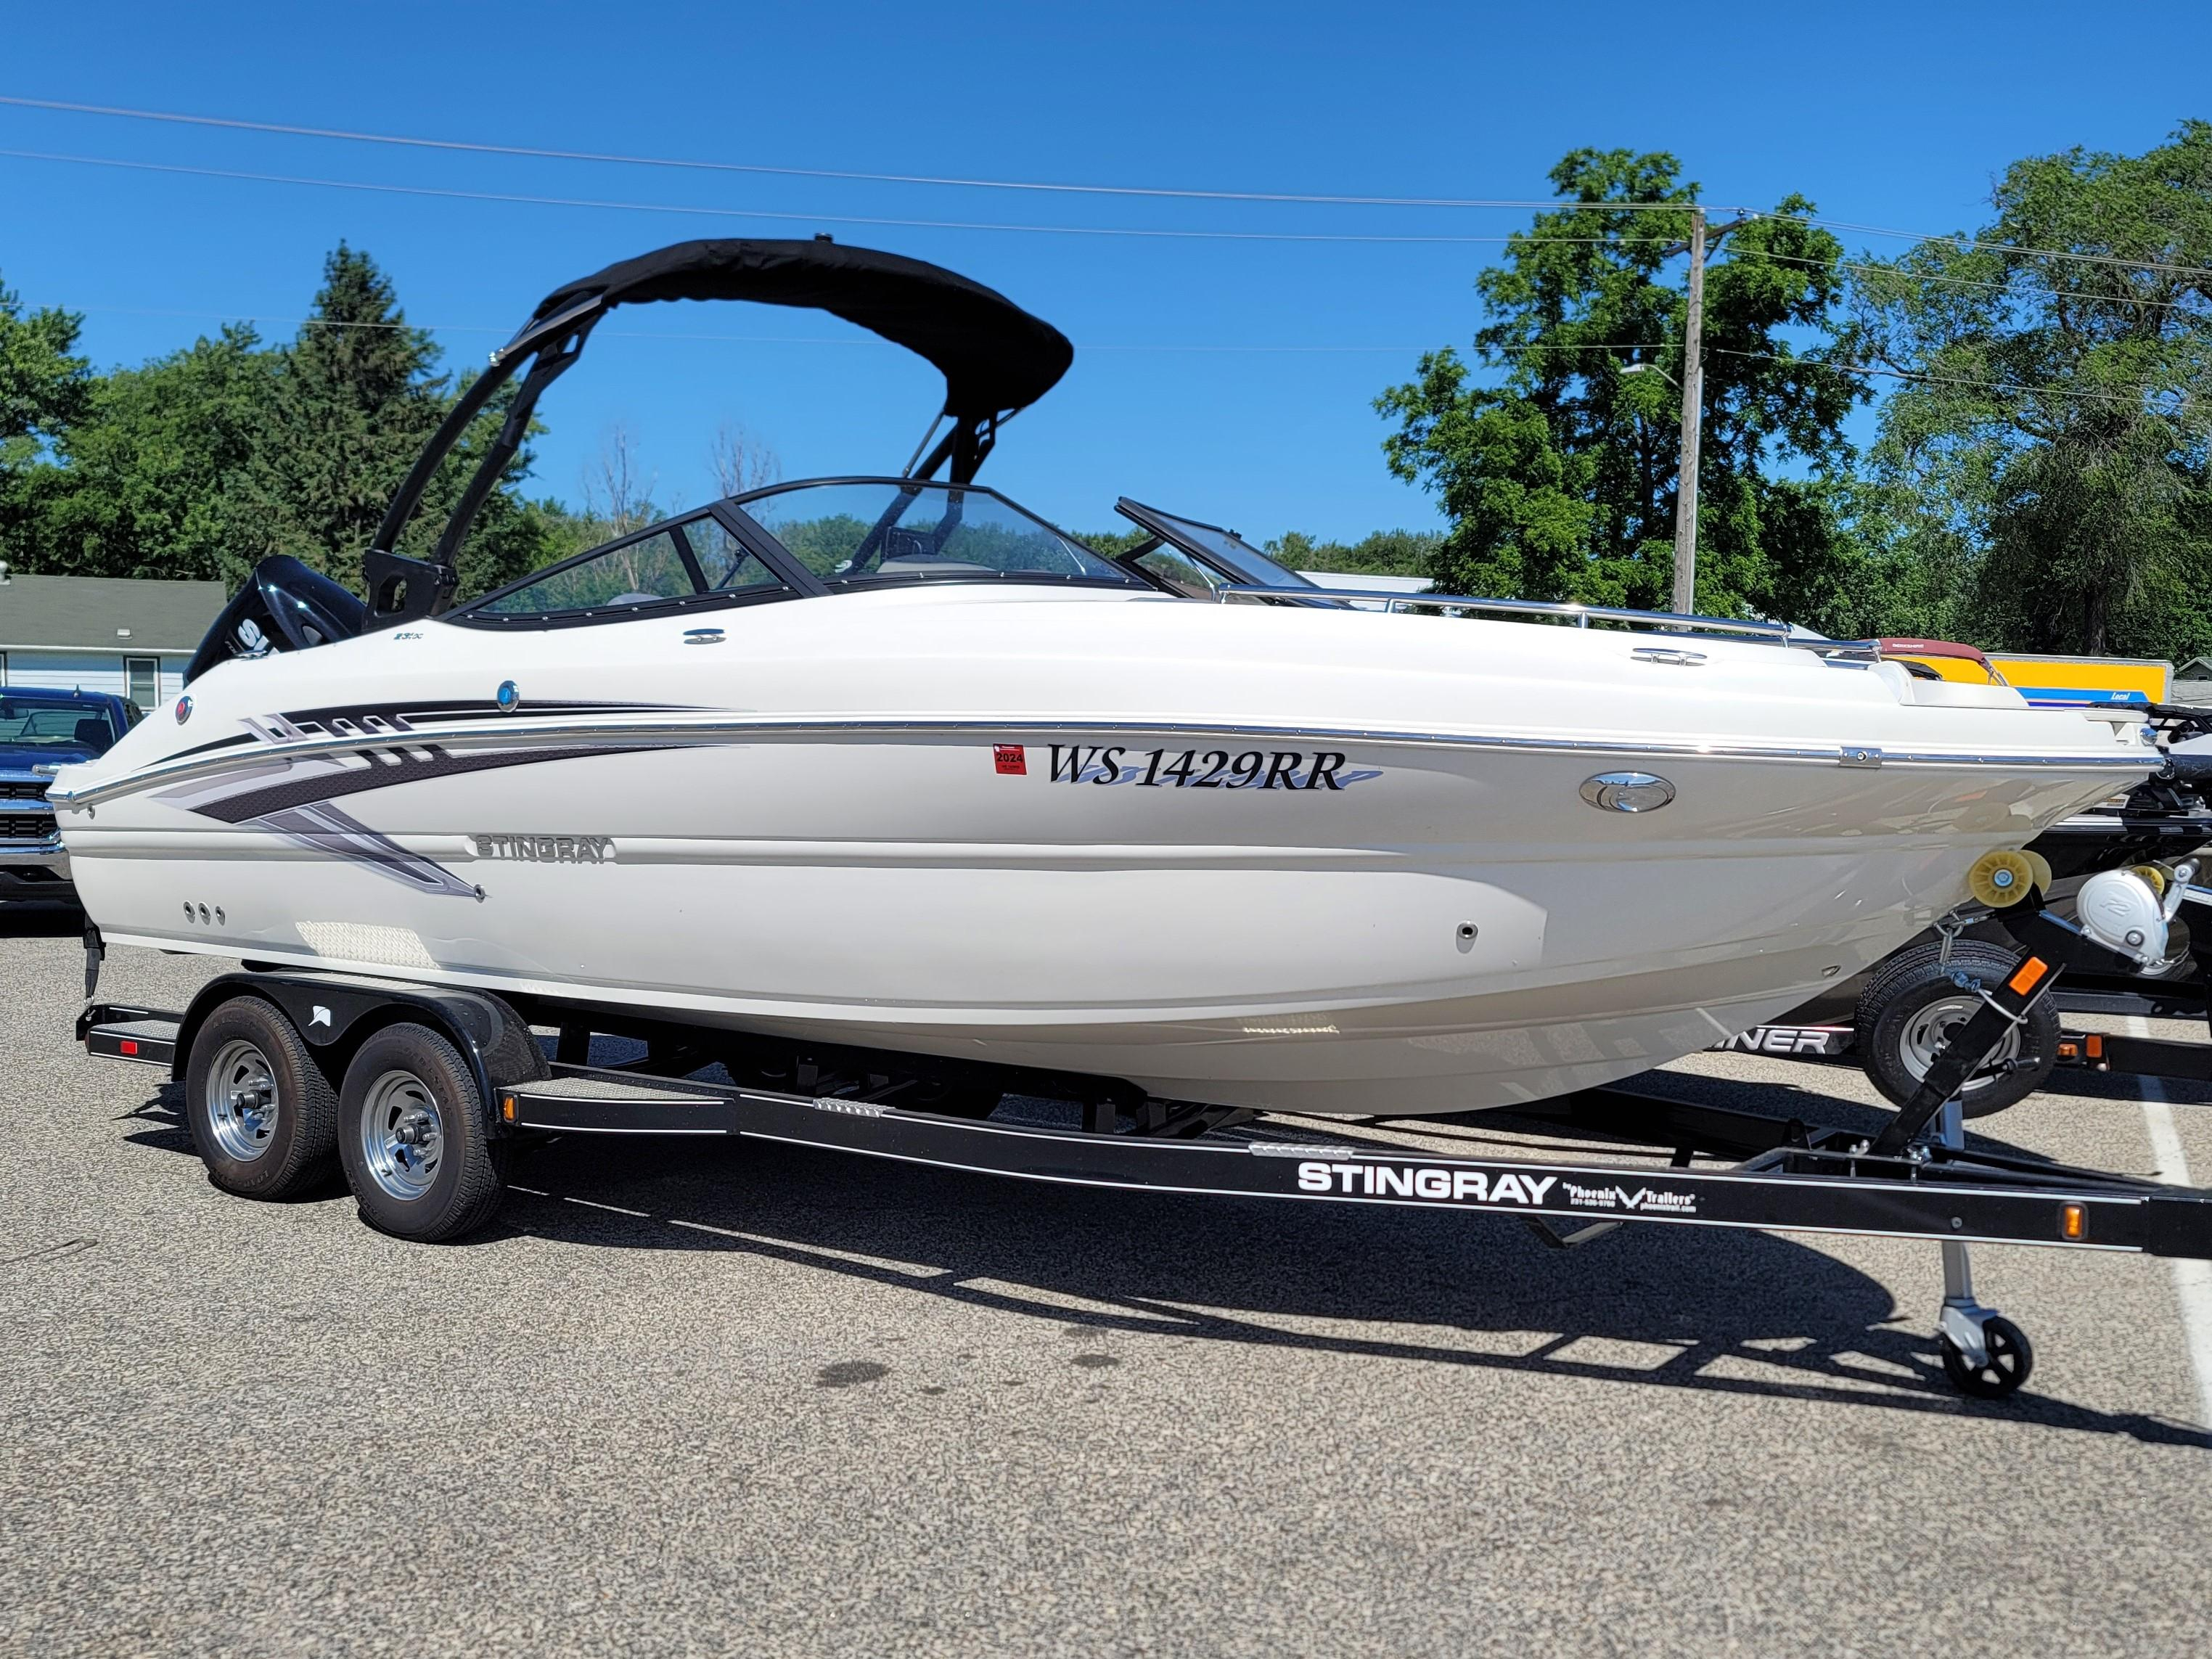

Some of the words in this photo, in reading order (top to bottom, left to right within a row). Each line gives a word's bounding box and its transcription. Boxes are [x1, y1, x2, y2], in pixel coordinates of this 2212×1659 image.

[2110, 692, 2131, 700] Local
[996, 753, 1023, 763] 2024
[1047, 744, 1126, 785] WS
[1136, 748, 1346, 790] 1429RR
[476, 835, 609, 864] STINGRAY
[1298, 1161, 1558, 1205] STINGRAY
[1570, 1185, 1616, 1200] Phoenix
